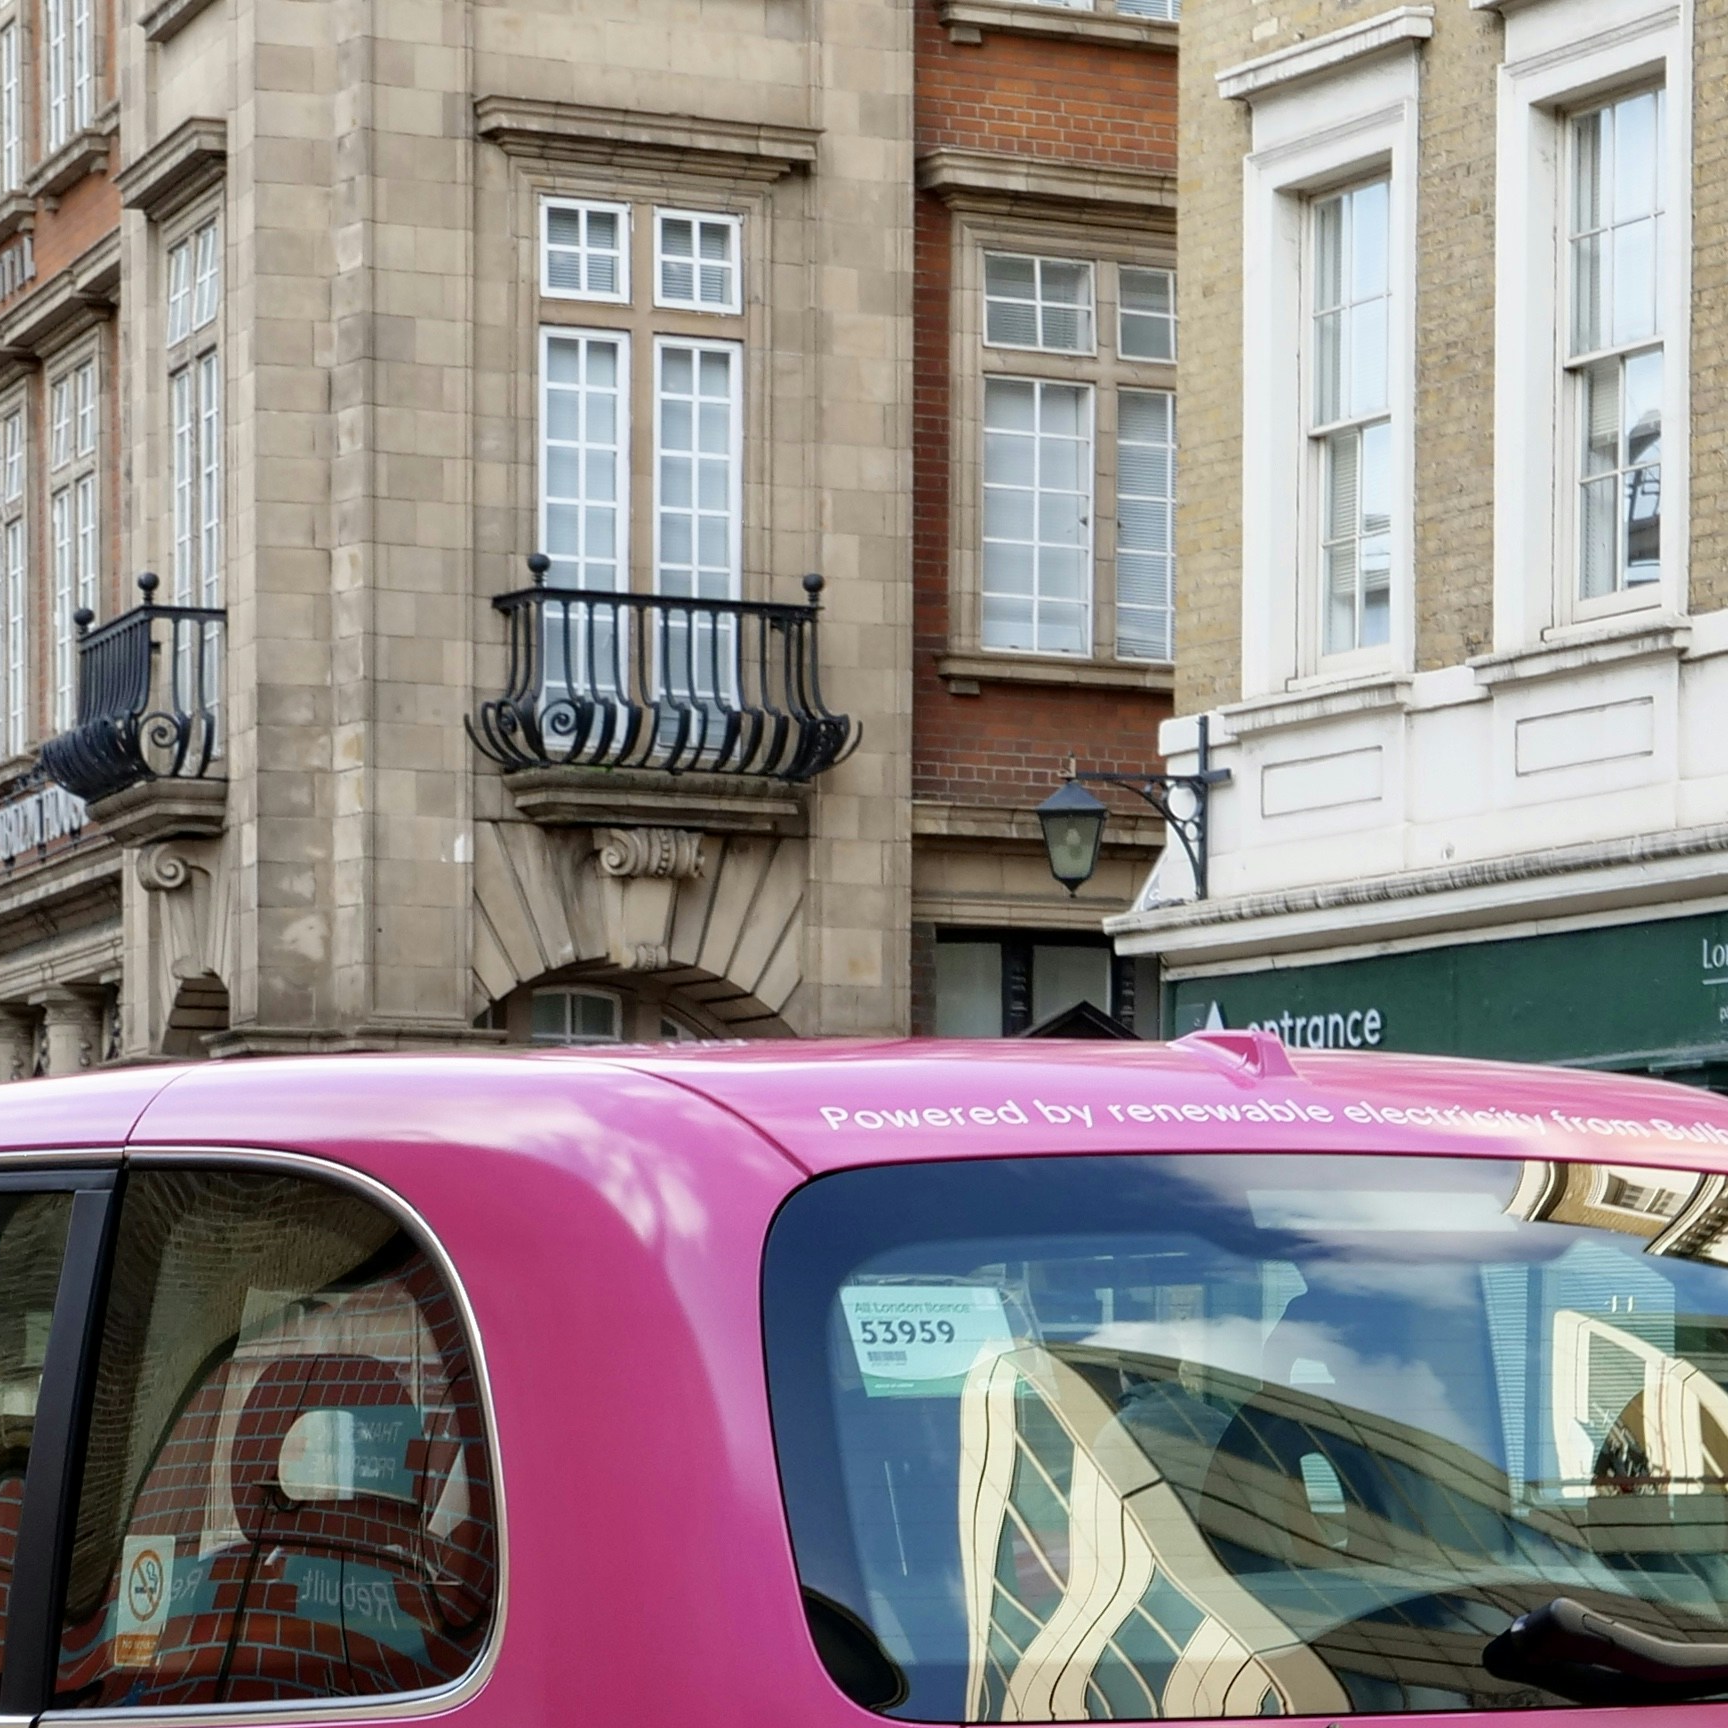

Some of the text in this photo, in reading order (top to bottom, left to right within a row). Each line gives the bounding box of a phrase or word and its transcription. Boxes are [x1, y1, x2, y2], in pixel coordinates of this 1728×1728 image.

[819, 1100, 1029, 1131] Powered
[1033, 1099, 1094, 1129] by
[1107, 1098, 1334, 1123] renewable
[1342, 1101, 1546, 1135] electricity
[1552, 1110, 1650, 1138] from
[873, 1302, 922, 1314] London
[860, 1319, 956, 1345] 53959
